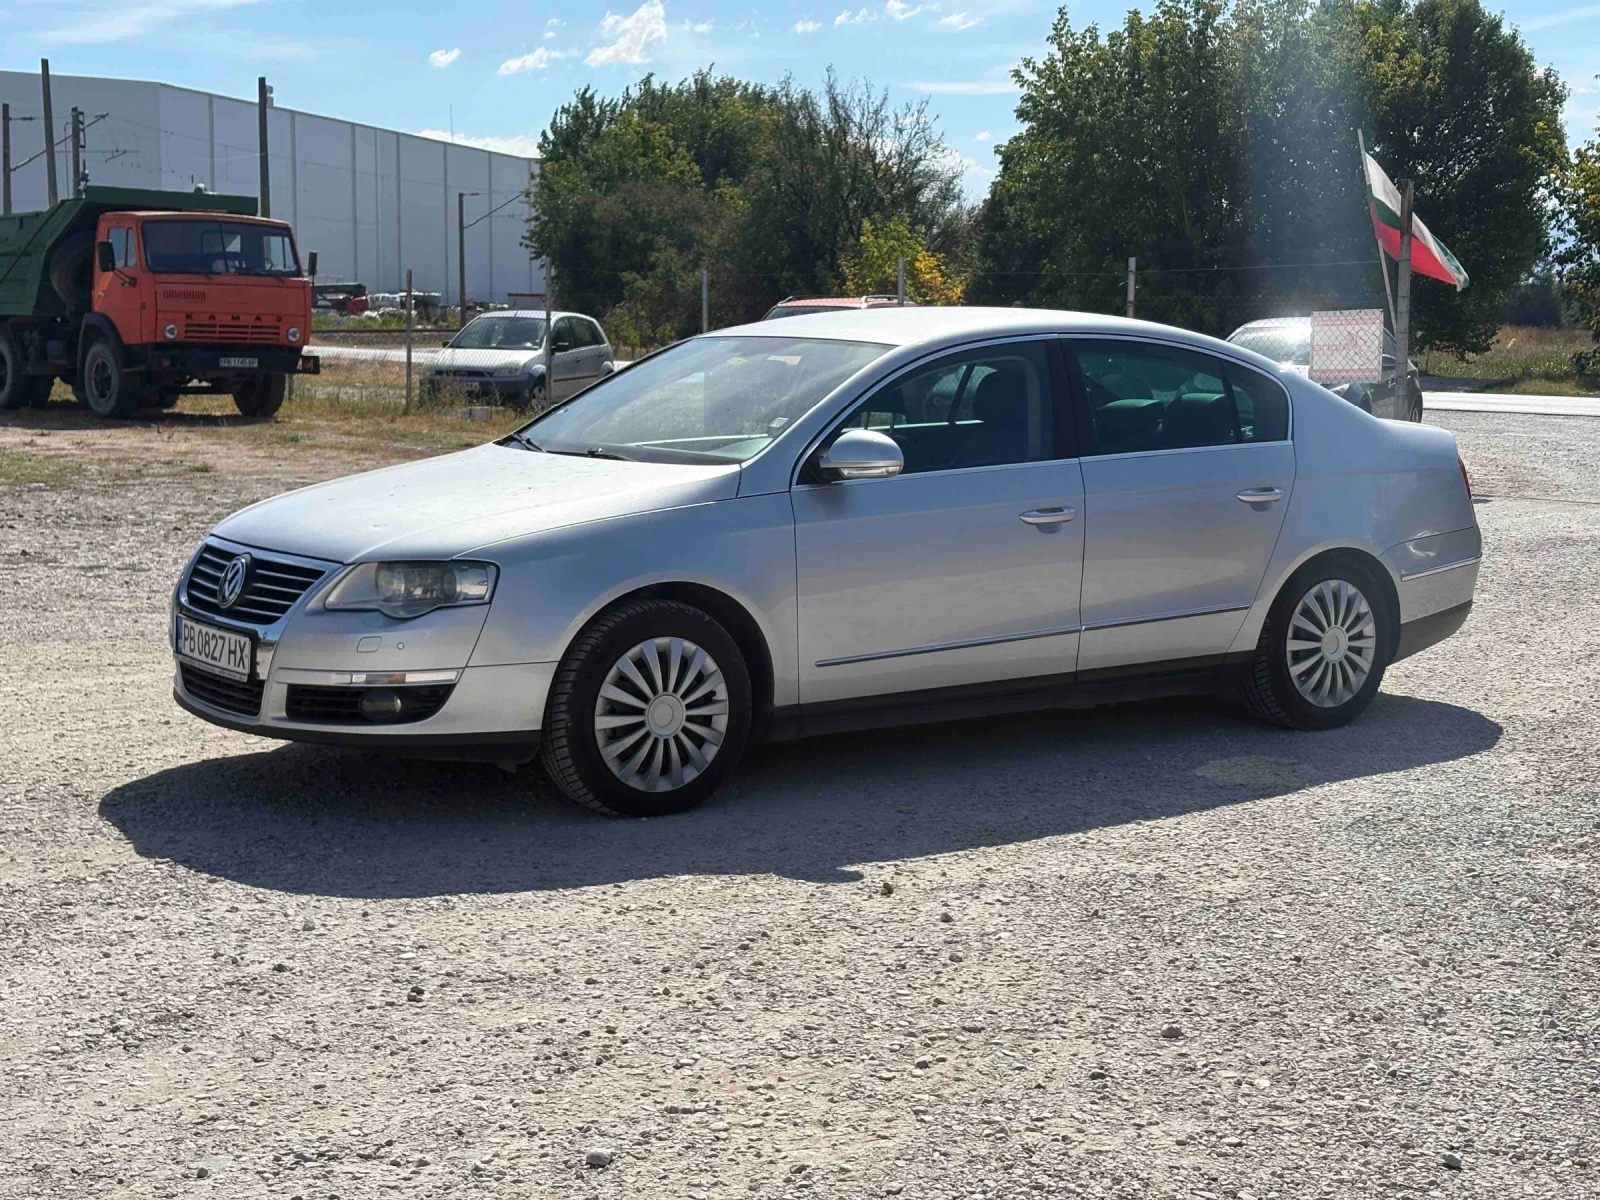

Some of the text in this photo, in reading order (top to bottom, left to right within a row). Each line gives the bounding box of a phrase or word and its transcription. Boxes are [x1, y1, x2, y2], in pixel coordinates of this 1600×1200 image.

[183, 623, 196, 653] PB
[197, 629, 226, 662] 0827
[228, 637, 247, 670] HX
